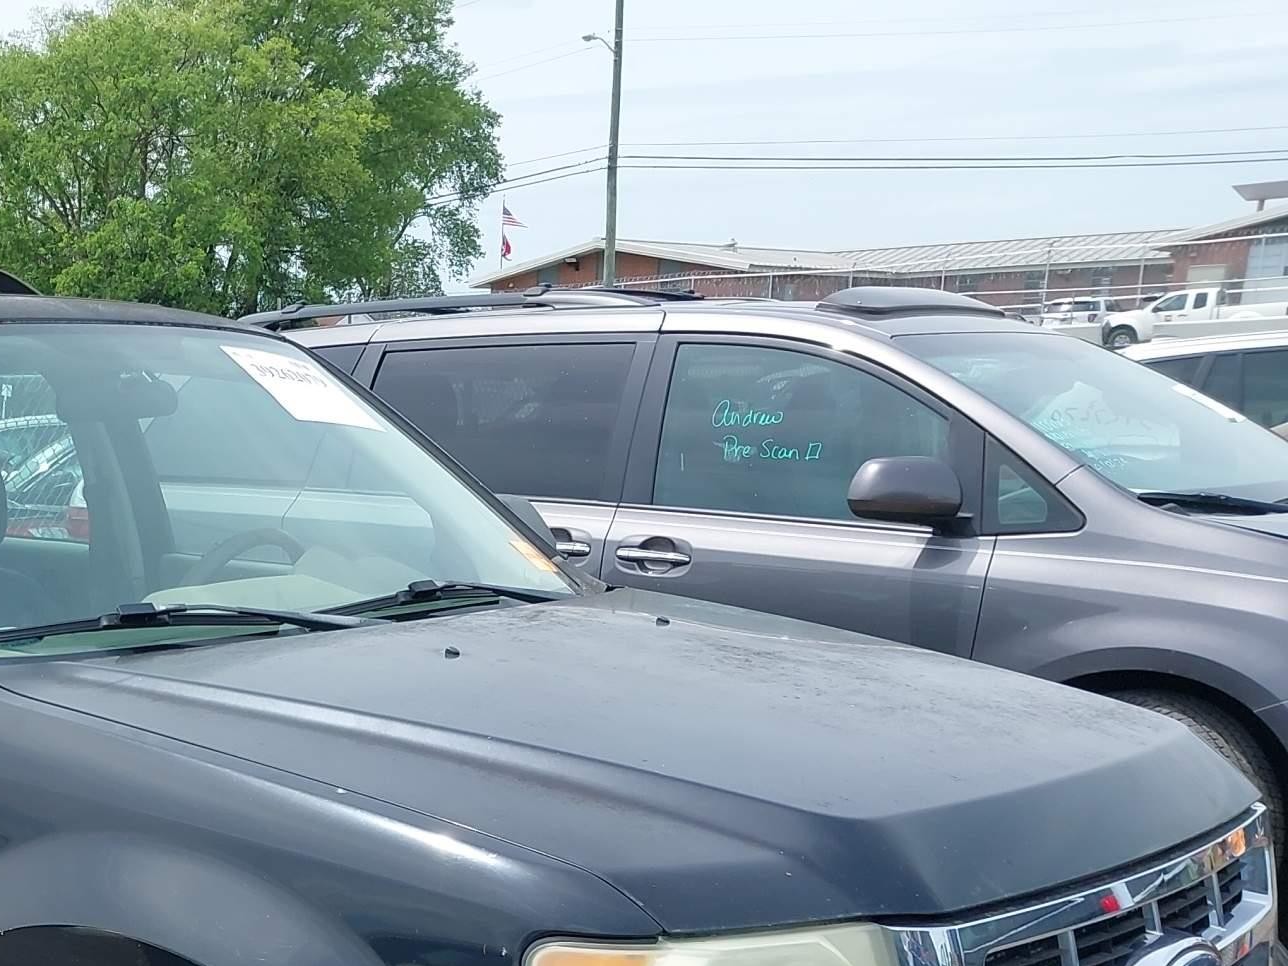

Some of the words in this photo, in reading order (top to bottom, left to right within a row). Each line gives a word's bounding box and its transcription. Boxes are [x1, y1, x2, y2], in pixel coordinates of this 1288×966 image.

[712, 399, 785, 428] Andrew
[722, 434, 752, 461] Pre
[759, 438, 800, 461] Scan
